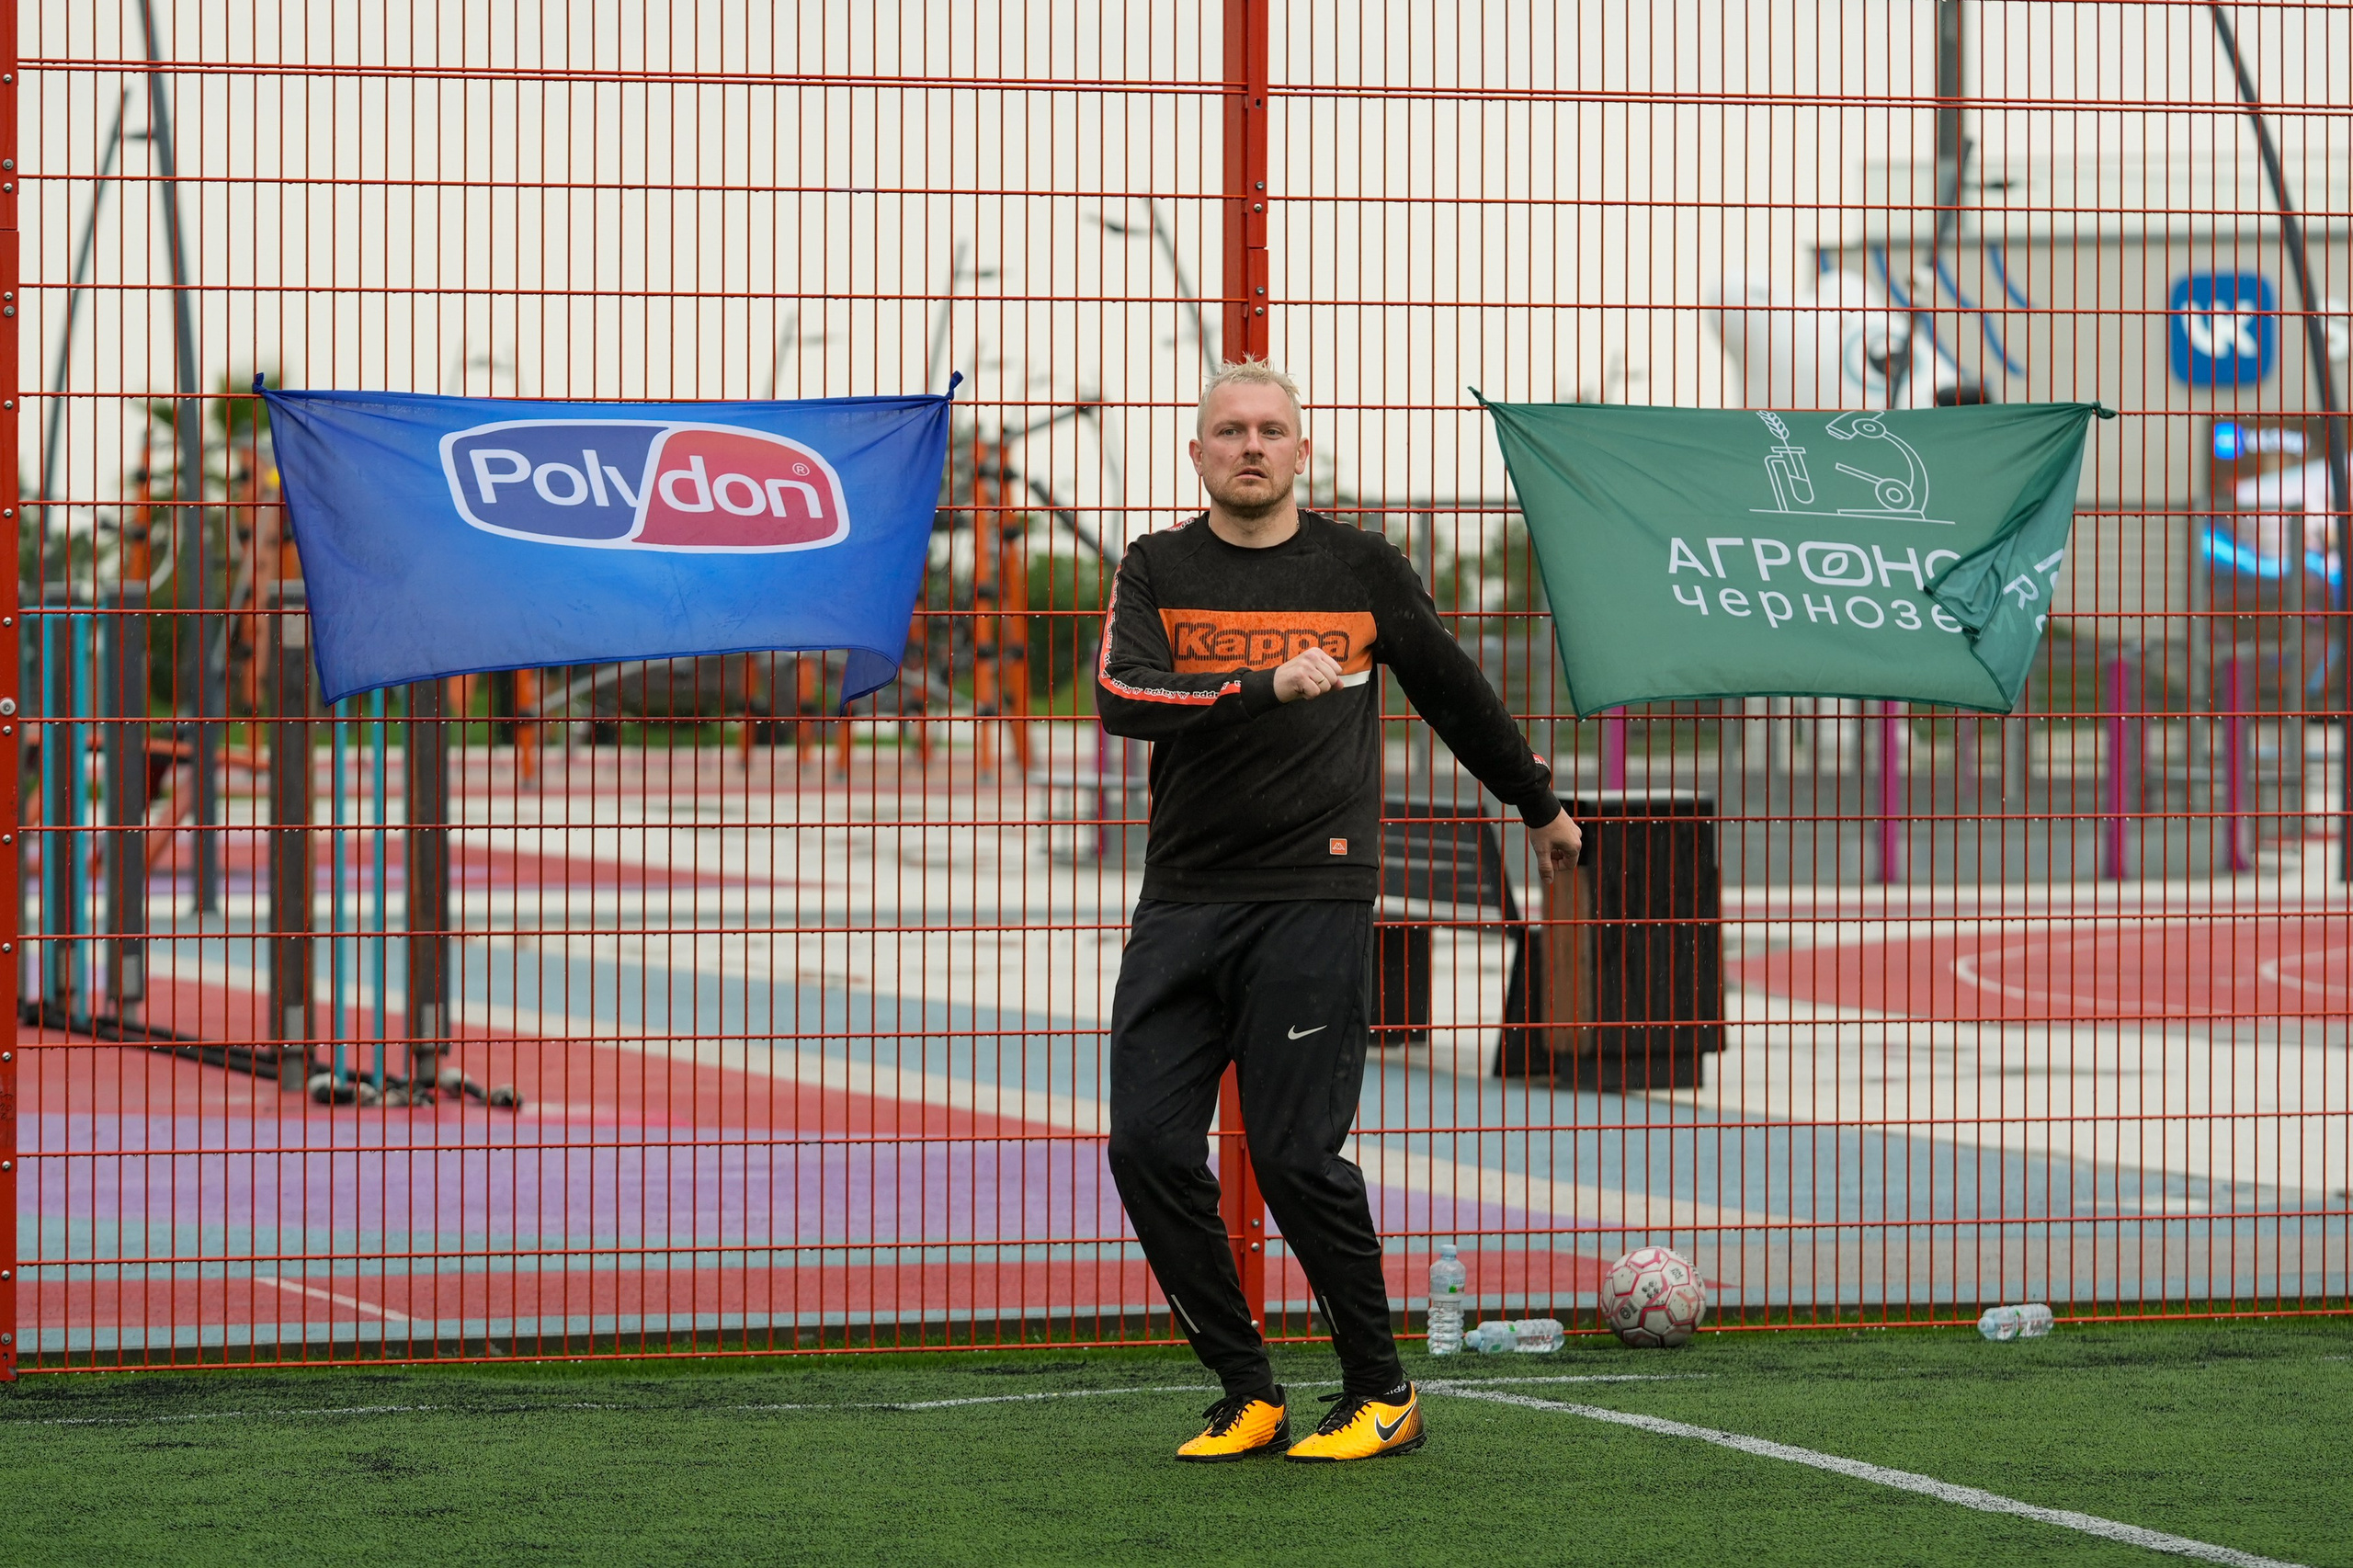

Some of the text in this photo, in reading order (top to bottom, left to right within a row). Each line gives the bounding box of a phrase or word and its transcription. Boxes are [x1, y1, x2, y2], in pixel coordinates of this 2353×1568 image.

[2179, 298, 2257, 358] VK
[469, 449, 824, 519] Polydon
[1175, 621, 1350, 666] Kappa
